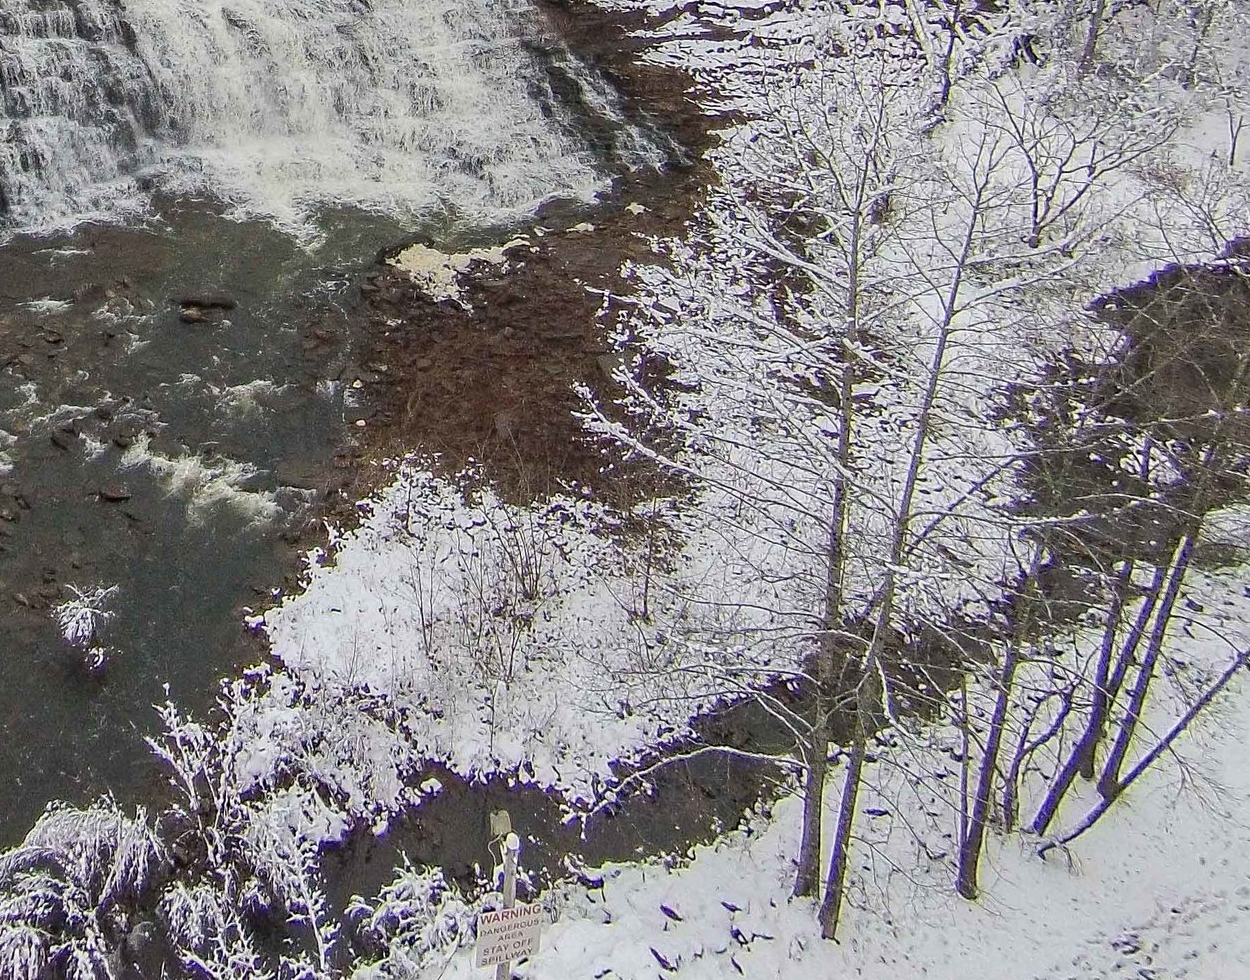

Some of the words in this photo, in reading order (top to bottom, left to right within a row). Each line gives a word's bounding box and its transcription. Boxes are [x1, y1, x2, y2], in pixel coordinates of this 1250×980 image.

[481, 904, 541, 925] WARNING
[481, 920, 539, 937] DANGEROUS
[498, 931, 523, 941] AREA
[483, 944, 509, 956] STAY
[513, 938, 533, 949] OFF
[482, 948, 533, 965] SPILLWAY
